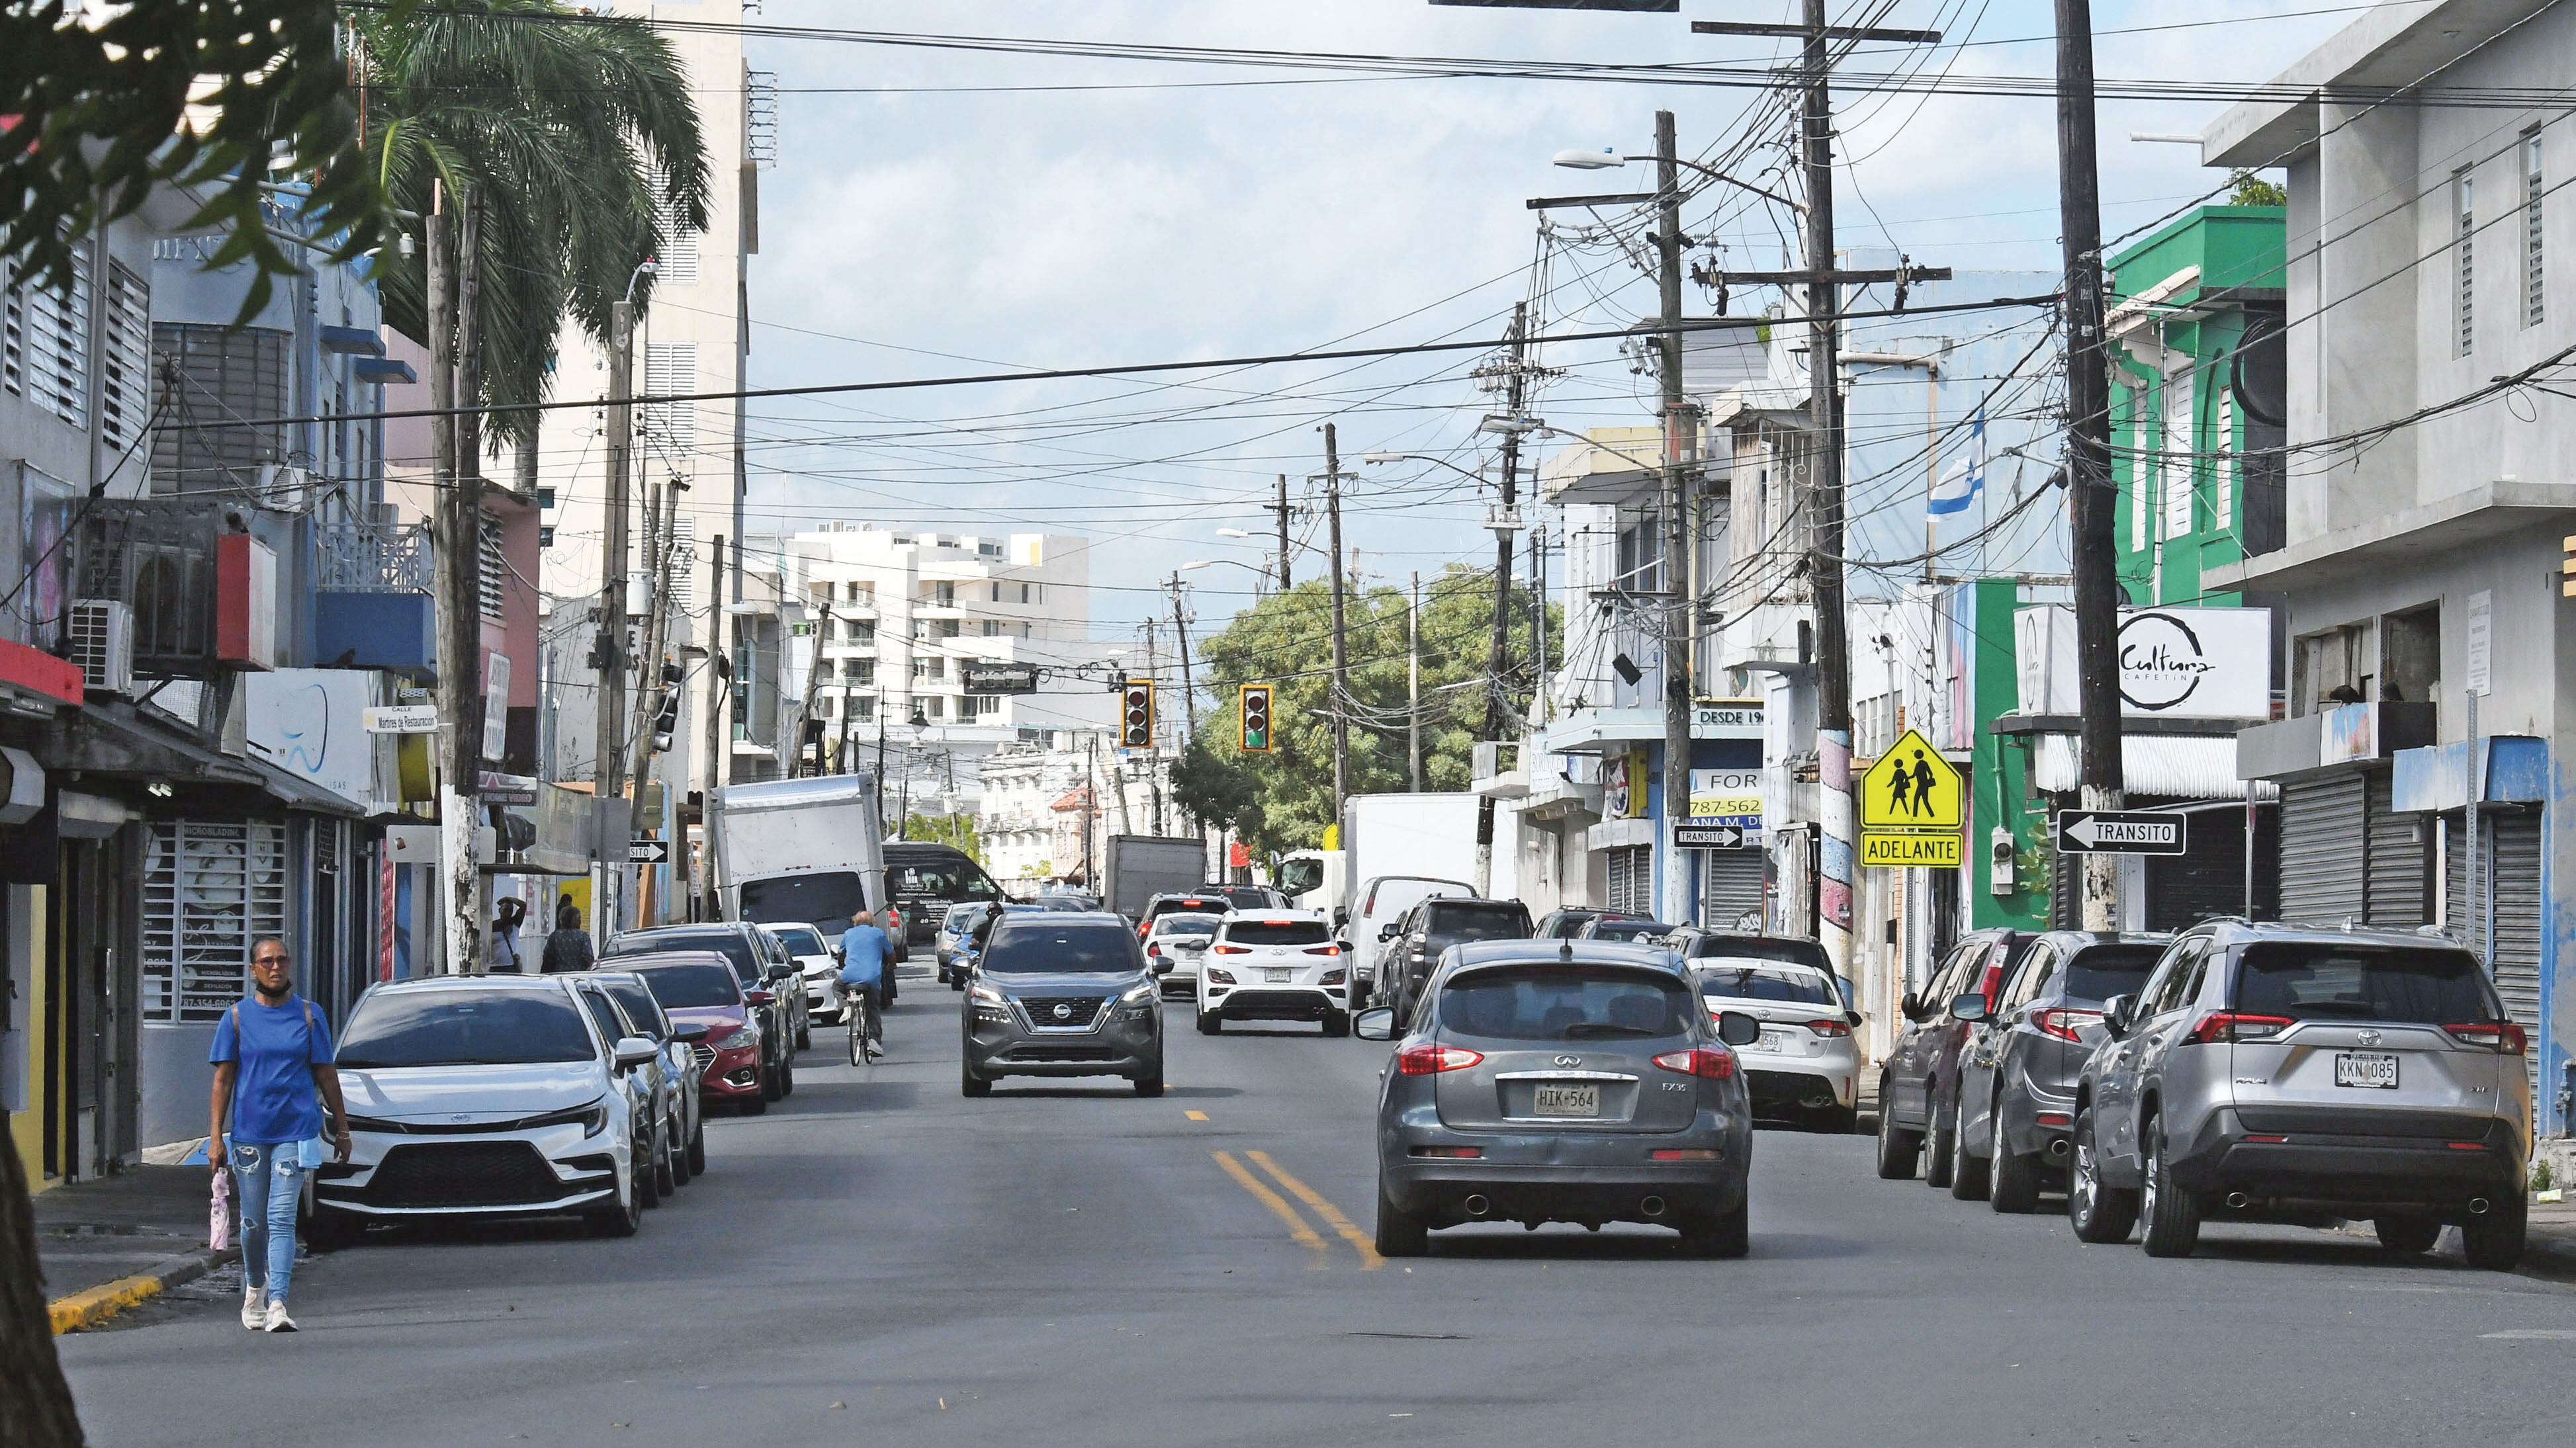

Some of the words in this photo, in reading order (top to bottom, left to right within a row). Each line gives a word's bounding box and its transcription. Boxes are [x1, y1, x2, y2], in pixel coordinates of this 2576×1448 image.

[2120, 643, 2216, 673] Cultura
[398, 716, 404, 728] de
[1700, 712, 1742, 724] DESDE
[1710, 775, 1757, 789] FOR
[1681, 832, 1723, 841] TRANSITO
[2096, 824, 2171, 841] TRANSITO
[631, 848, 648, 857] SITO
[1867, 841, 1956, 859] ADELANTE
[1764, 1037, 1779, 1046] 568
[2340, 1062, 2363, 1078] KKN
[2371, 1063, 2393, 1078] 085
[1539, 1090, 1593, 1107] HIK-564
